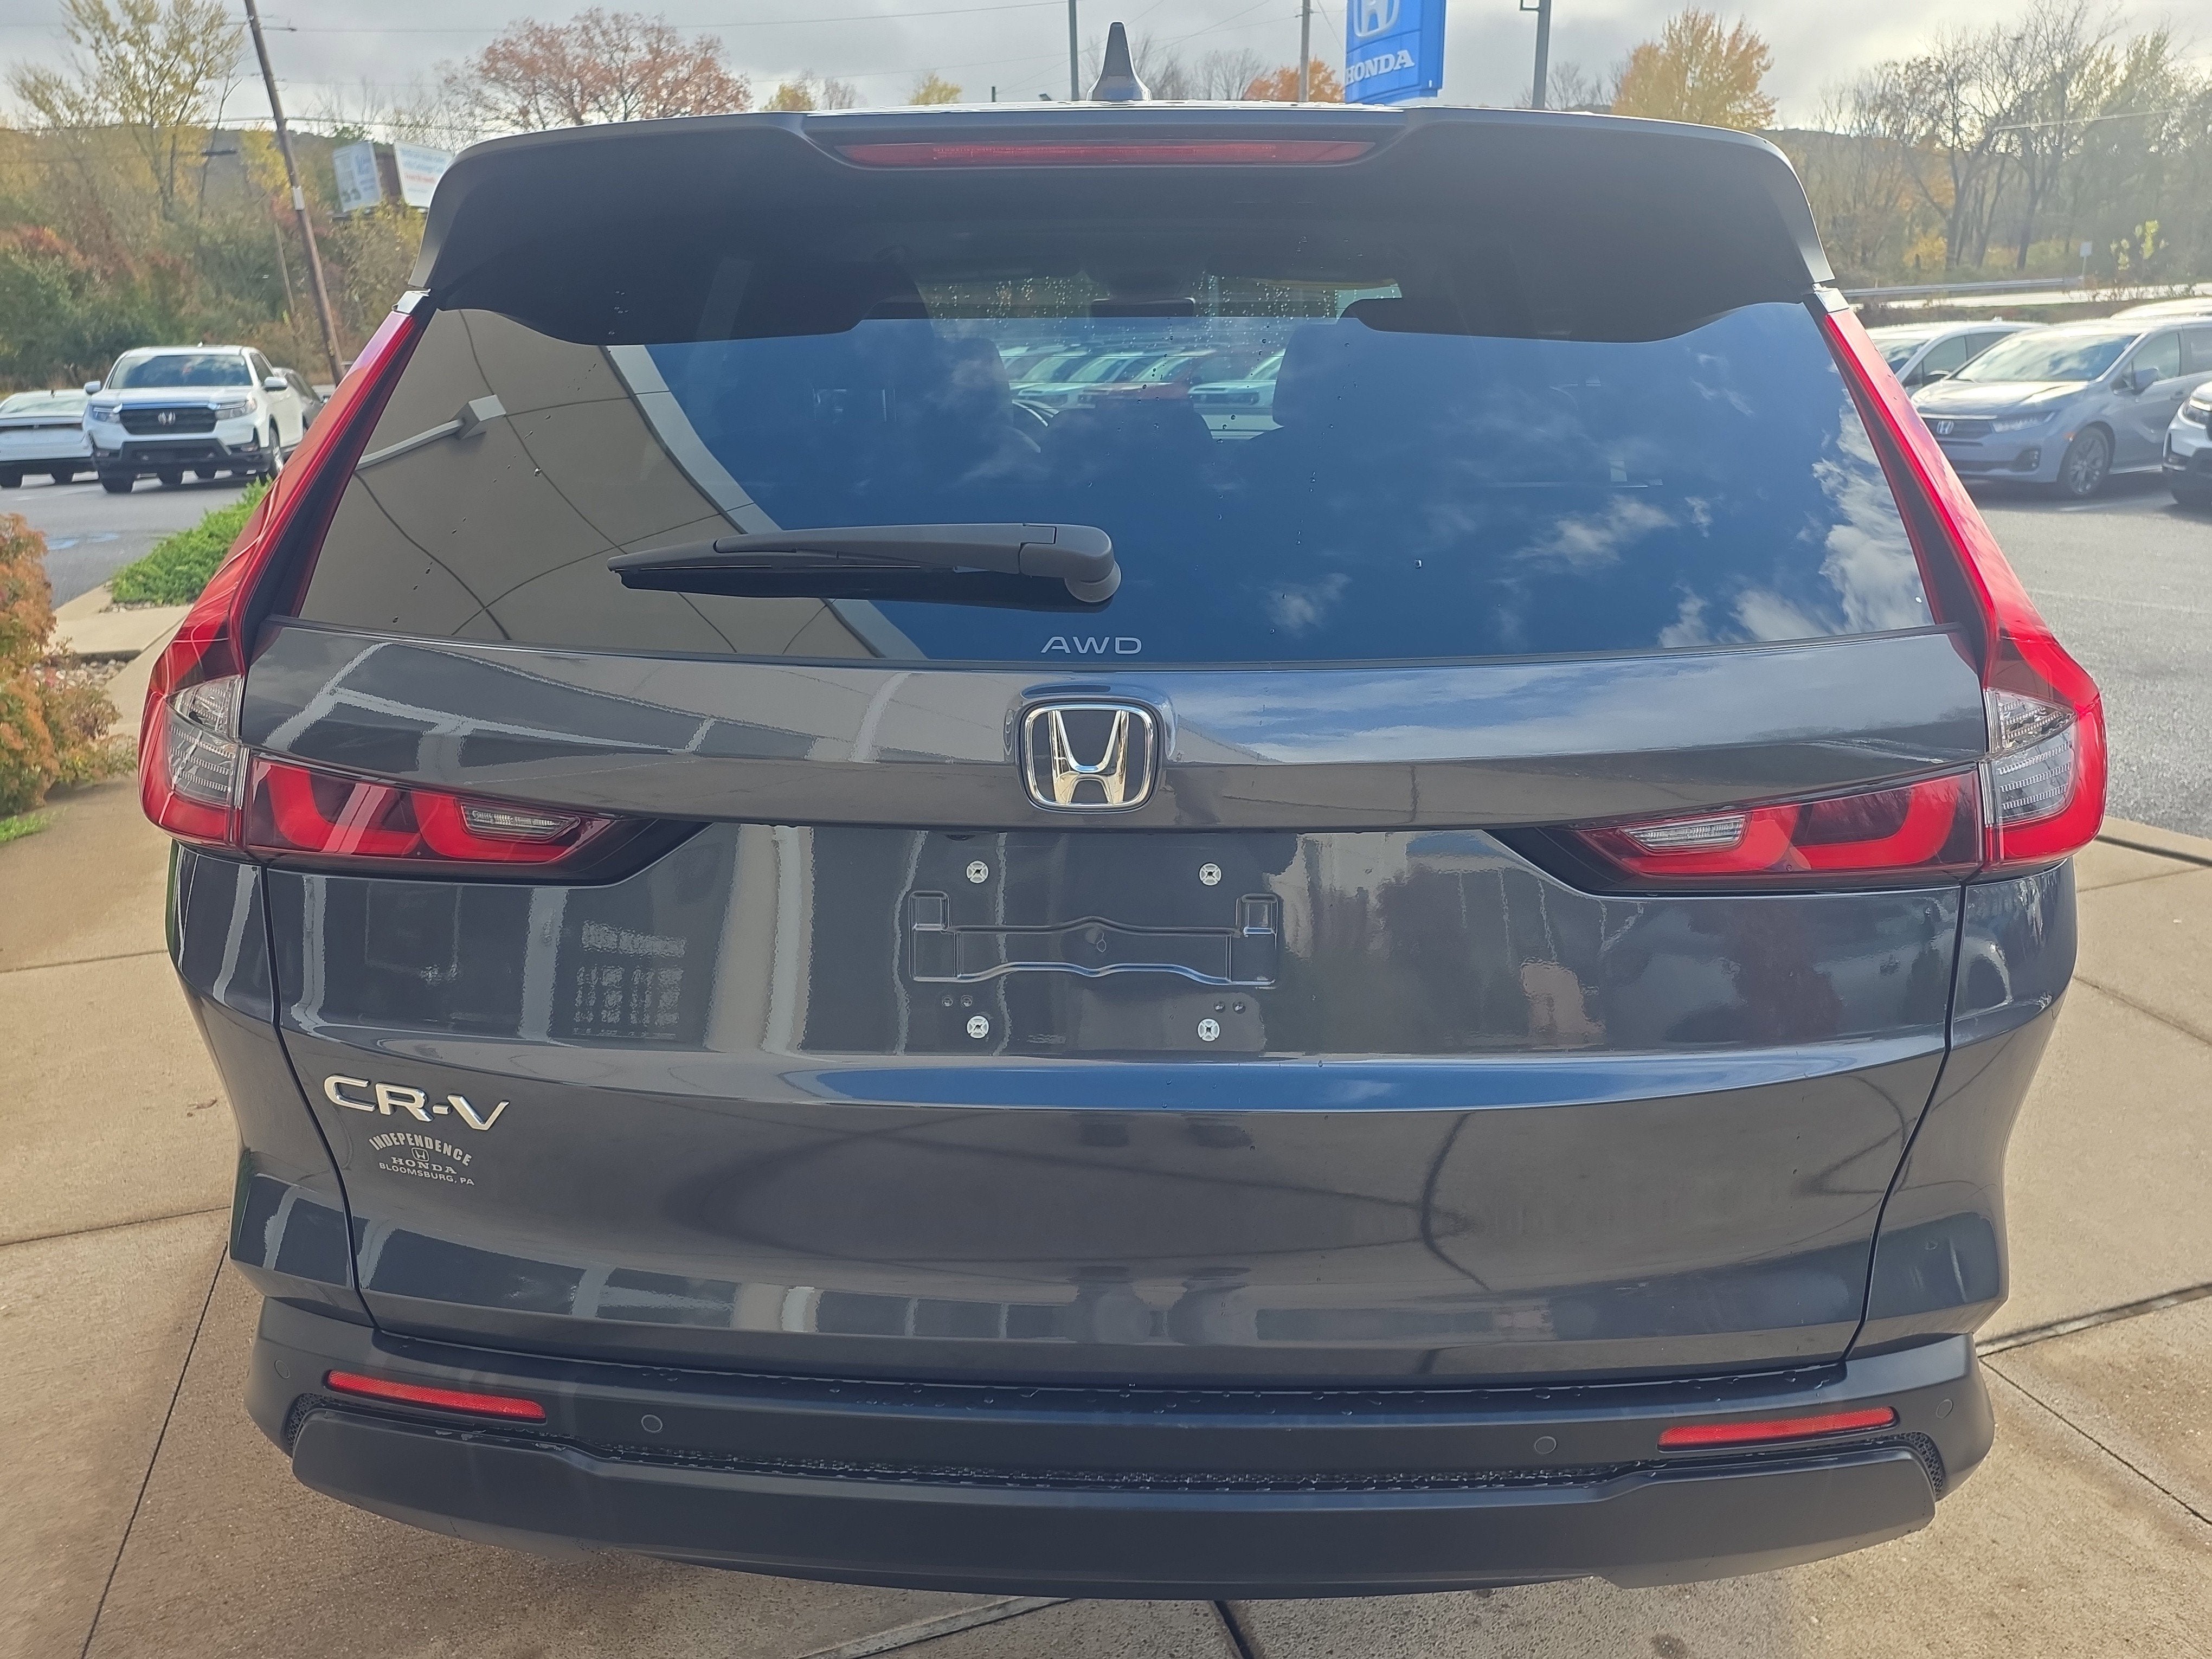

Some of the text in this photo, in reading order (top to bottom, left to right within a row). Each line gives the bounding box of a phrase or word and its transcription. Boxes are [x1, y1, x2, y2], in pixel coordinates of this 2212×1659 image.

[1346, 50, 1415, 86] HONDA
[1040, 636, 1142, 654] AWD
[324, 1073, 510, 1130] CR-V
[369, 1133, 473, 1166] INDEPENDENCE
[379, 1162, 475, 1186] BLOOMSBURG, PA
[391, 1156, 457, 1174] HONDA
